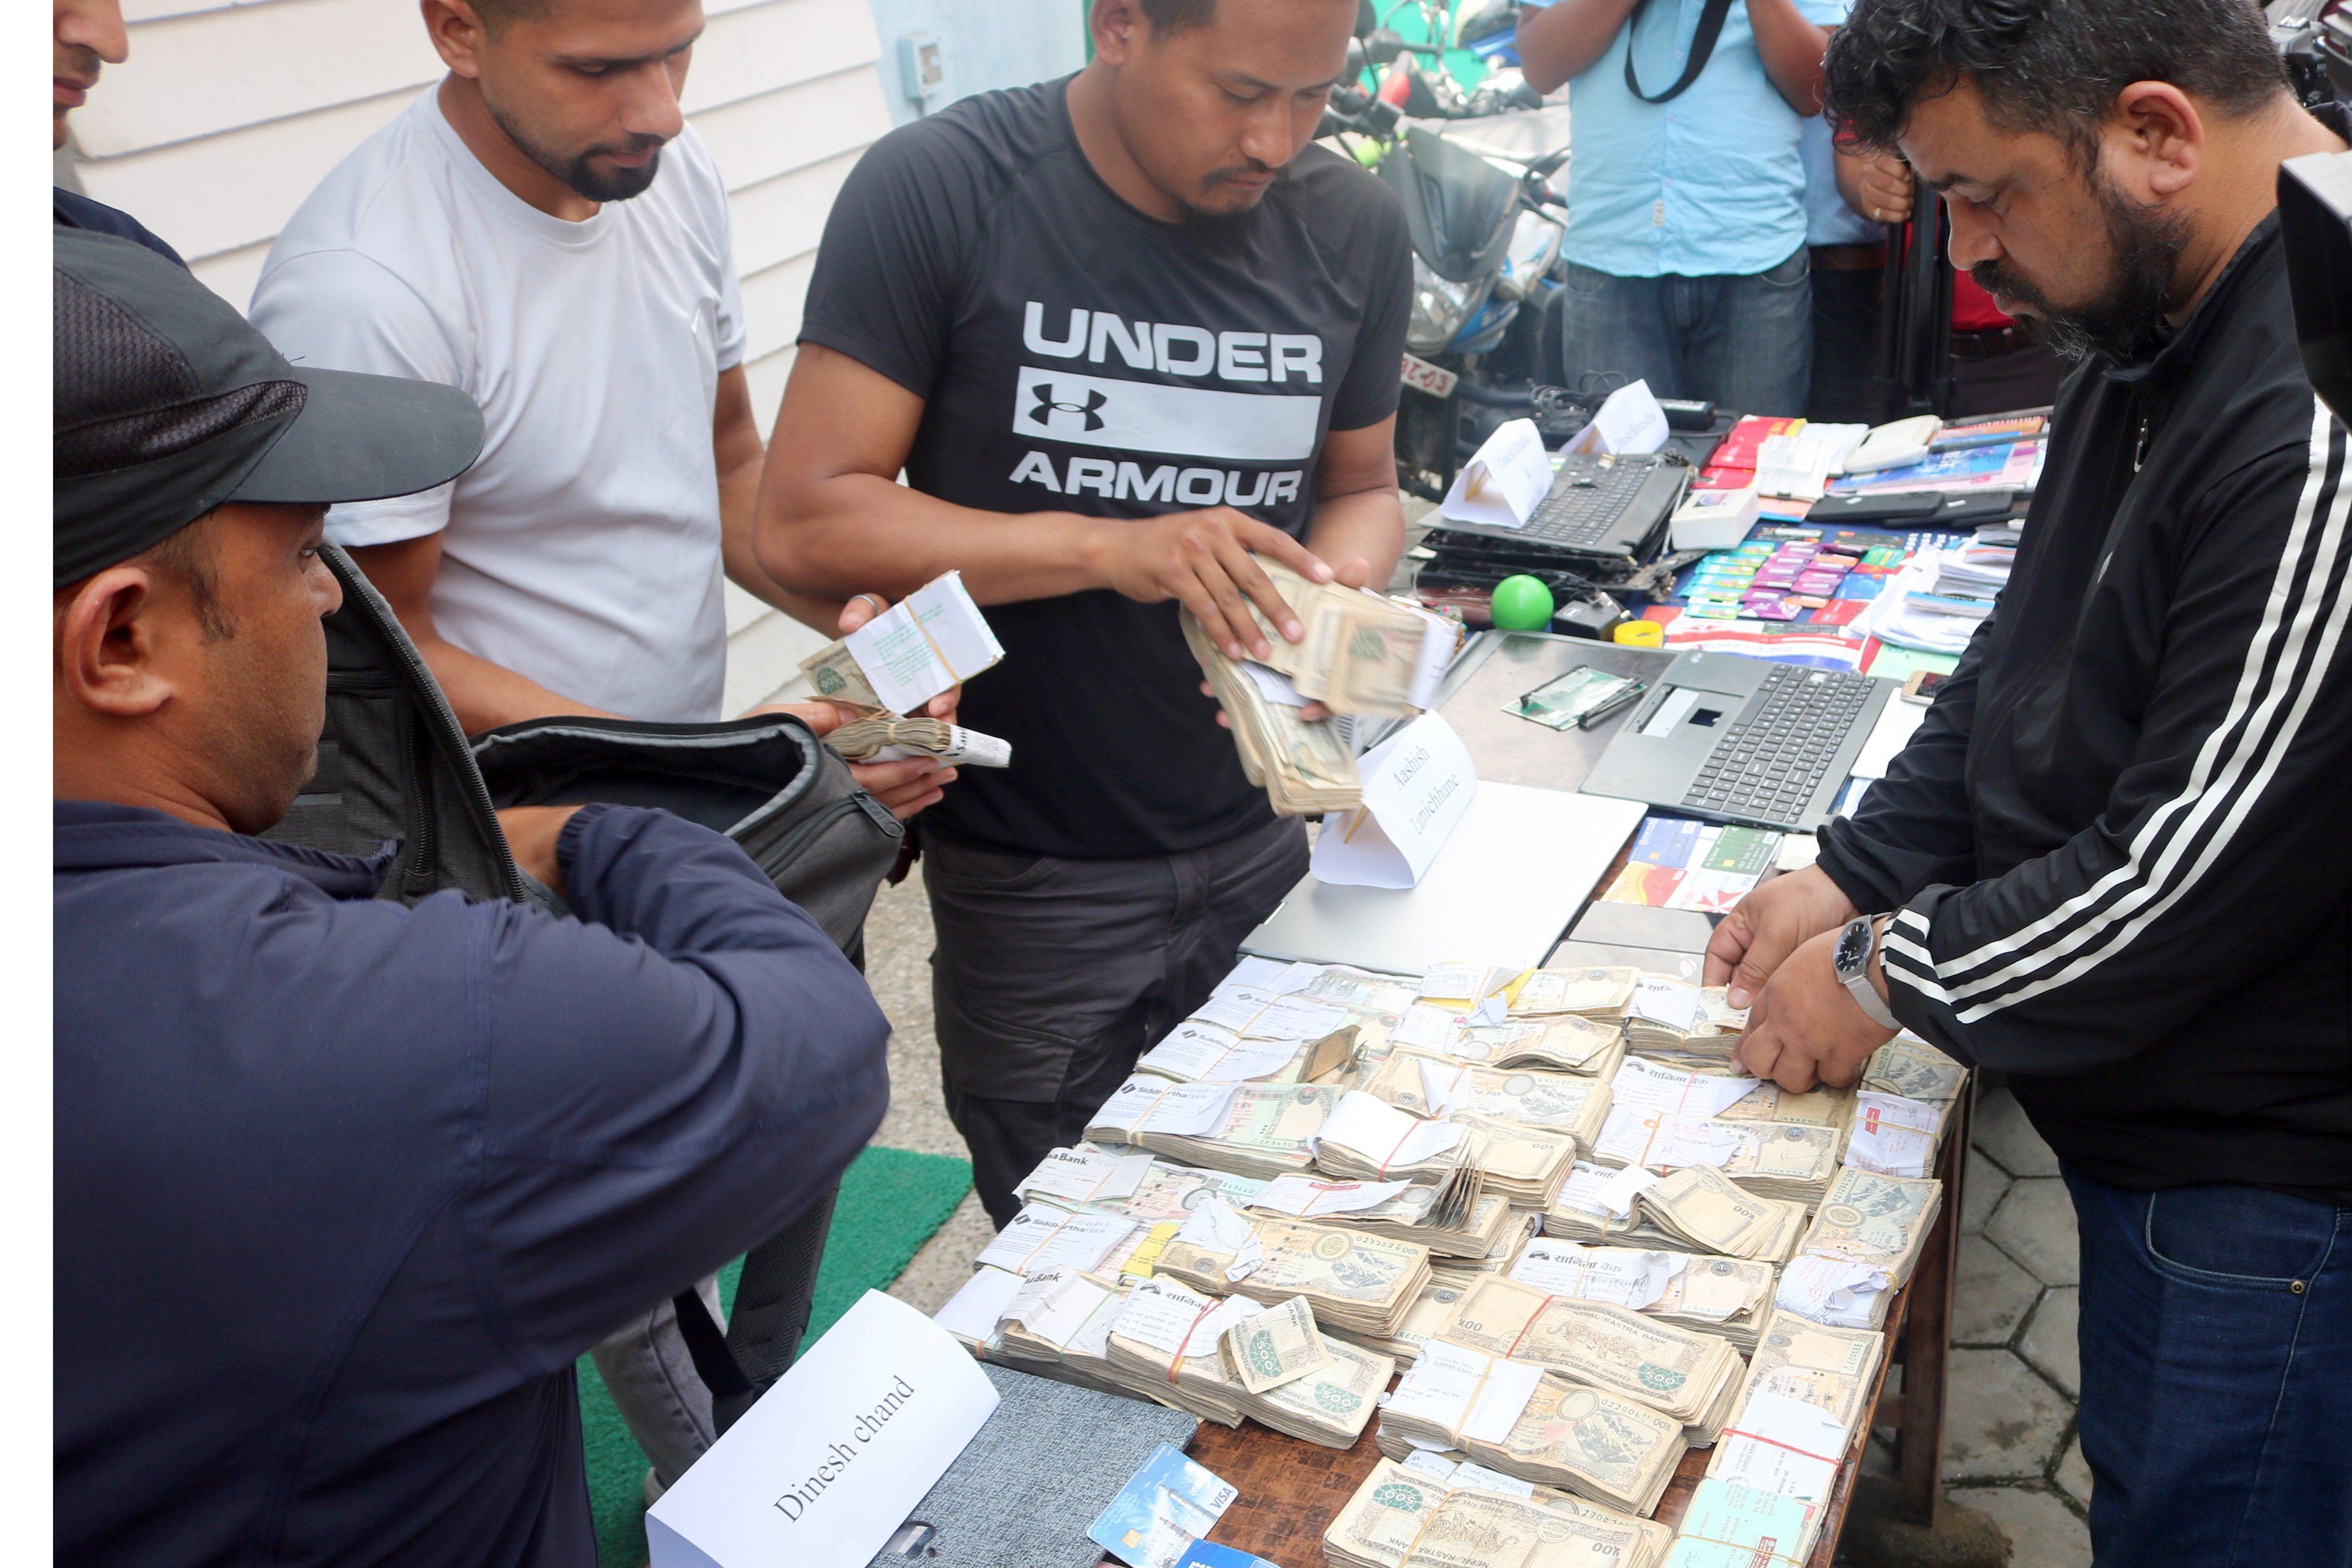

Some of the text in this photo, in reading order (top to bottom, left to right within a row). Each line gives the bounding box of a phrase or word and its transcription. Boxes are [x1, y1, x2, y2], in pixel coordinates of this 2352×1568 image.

[1022, 301, 1322, 384] UNDER
[1009, 450, 1303, 507] ARMOUR
[1392, 745, 1431, 791] Aashish
[1059, 1152, 1089, 1166] Bank
[1036, 1272, 1064, 1283] Bank
[1285, 1303, 1299, 1328] BANK
[1458, 1317, 1484, 1332] ५००
[1571, 1309, 1669, 1346] NEPAL RASTRA BANK
[1255, 1339, 1274, 1371] 500
[1560, 1352, 1632, 1382] RUPEES FIVE HUNDRED
[1644, 1369, 1676, 1386] 500
[1320, 1390, 1352, 1407] 500
[772, 1375, 916, 1524] Dinesh chand
[1740, 1454, 1752, 1473] SUNRISE
[1209, 1486, 1234, 1509] VISA
[1384, 1490, 1416, 1505] 500
[1462, 1499, 1477, 1508] FIVE
[1478, 1502, 1504, 1514] RUPEES
[1389, 1537, 1412, 1551] ANK
[1591, 1541, 1621, 1559] ५००
[1419, 1546, 1456, 1562] RASTRA
